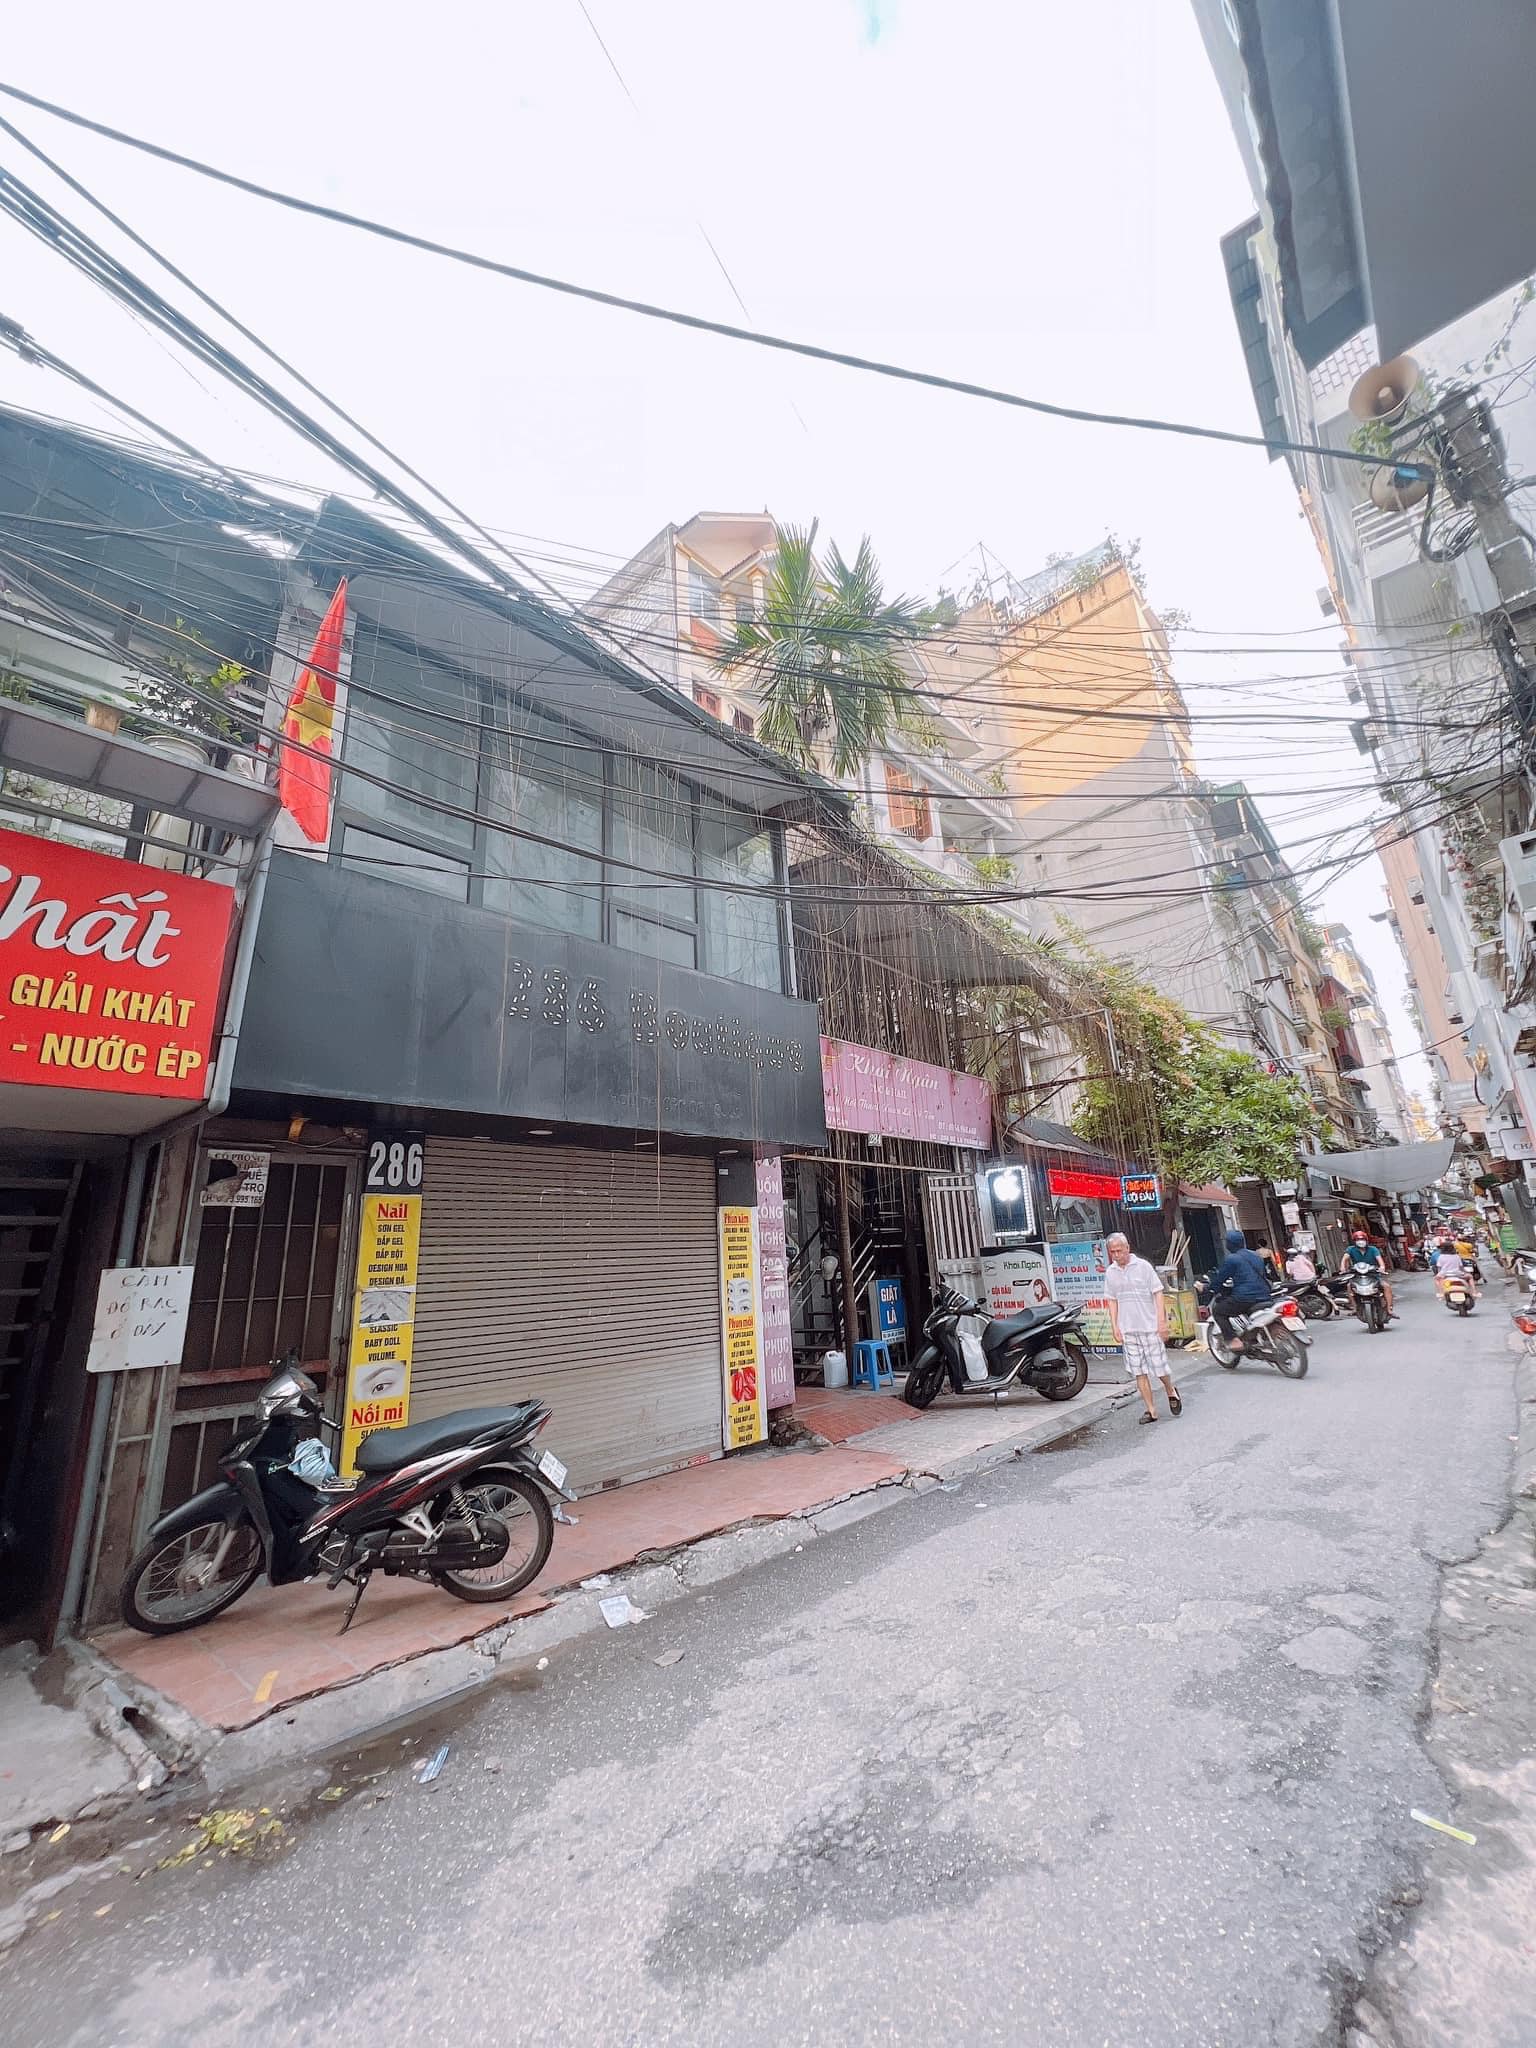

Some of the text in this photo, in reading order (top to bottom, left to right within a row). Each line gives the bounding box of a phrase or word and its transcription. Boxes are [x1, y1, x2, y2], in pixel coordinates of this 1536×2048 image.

[11, 971, 196, 1028] GIẢI KHÁT
[39, 1033, 146, 1074] NƯỚC
[156, 1044, 201, 1079] ÉP
[368, 1141, 423, 1187] 286
[377, 1202, 408, 1218] Nail
[378, 1223, 405, 1233] SƠN GEL
[376, 1236, 404, 1246] ĐẮP GEL
[375, 1248, 403, 1259] ĐẮP BỘT
[368, 1264, 393, 1272] DESIGN
[369, 1277, 394, 1286] DESIGN
[881, 1285, 897, 1304] GIẶT
[364, 1337, 401, 1348] BABY DOLL
[765, 1337, 789, 1358] PHỤC
[368, 1351, 396, 1362] VOLUME
[351, 1402, 403, 1426] Nối mi
